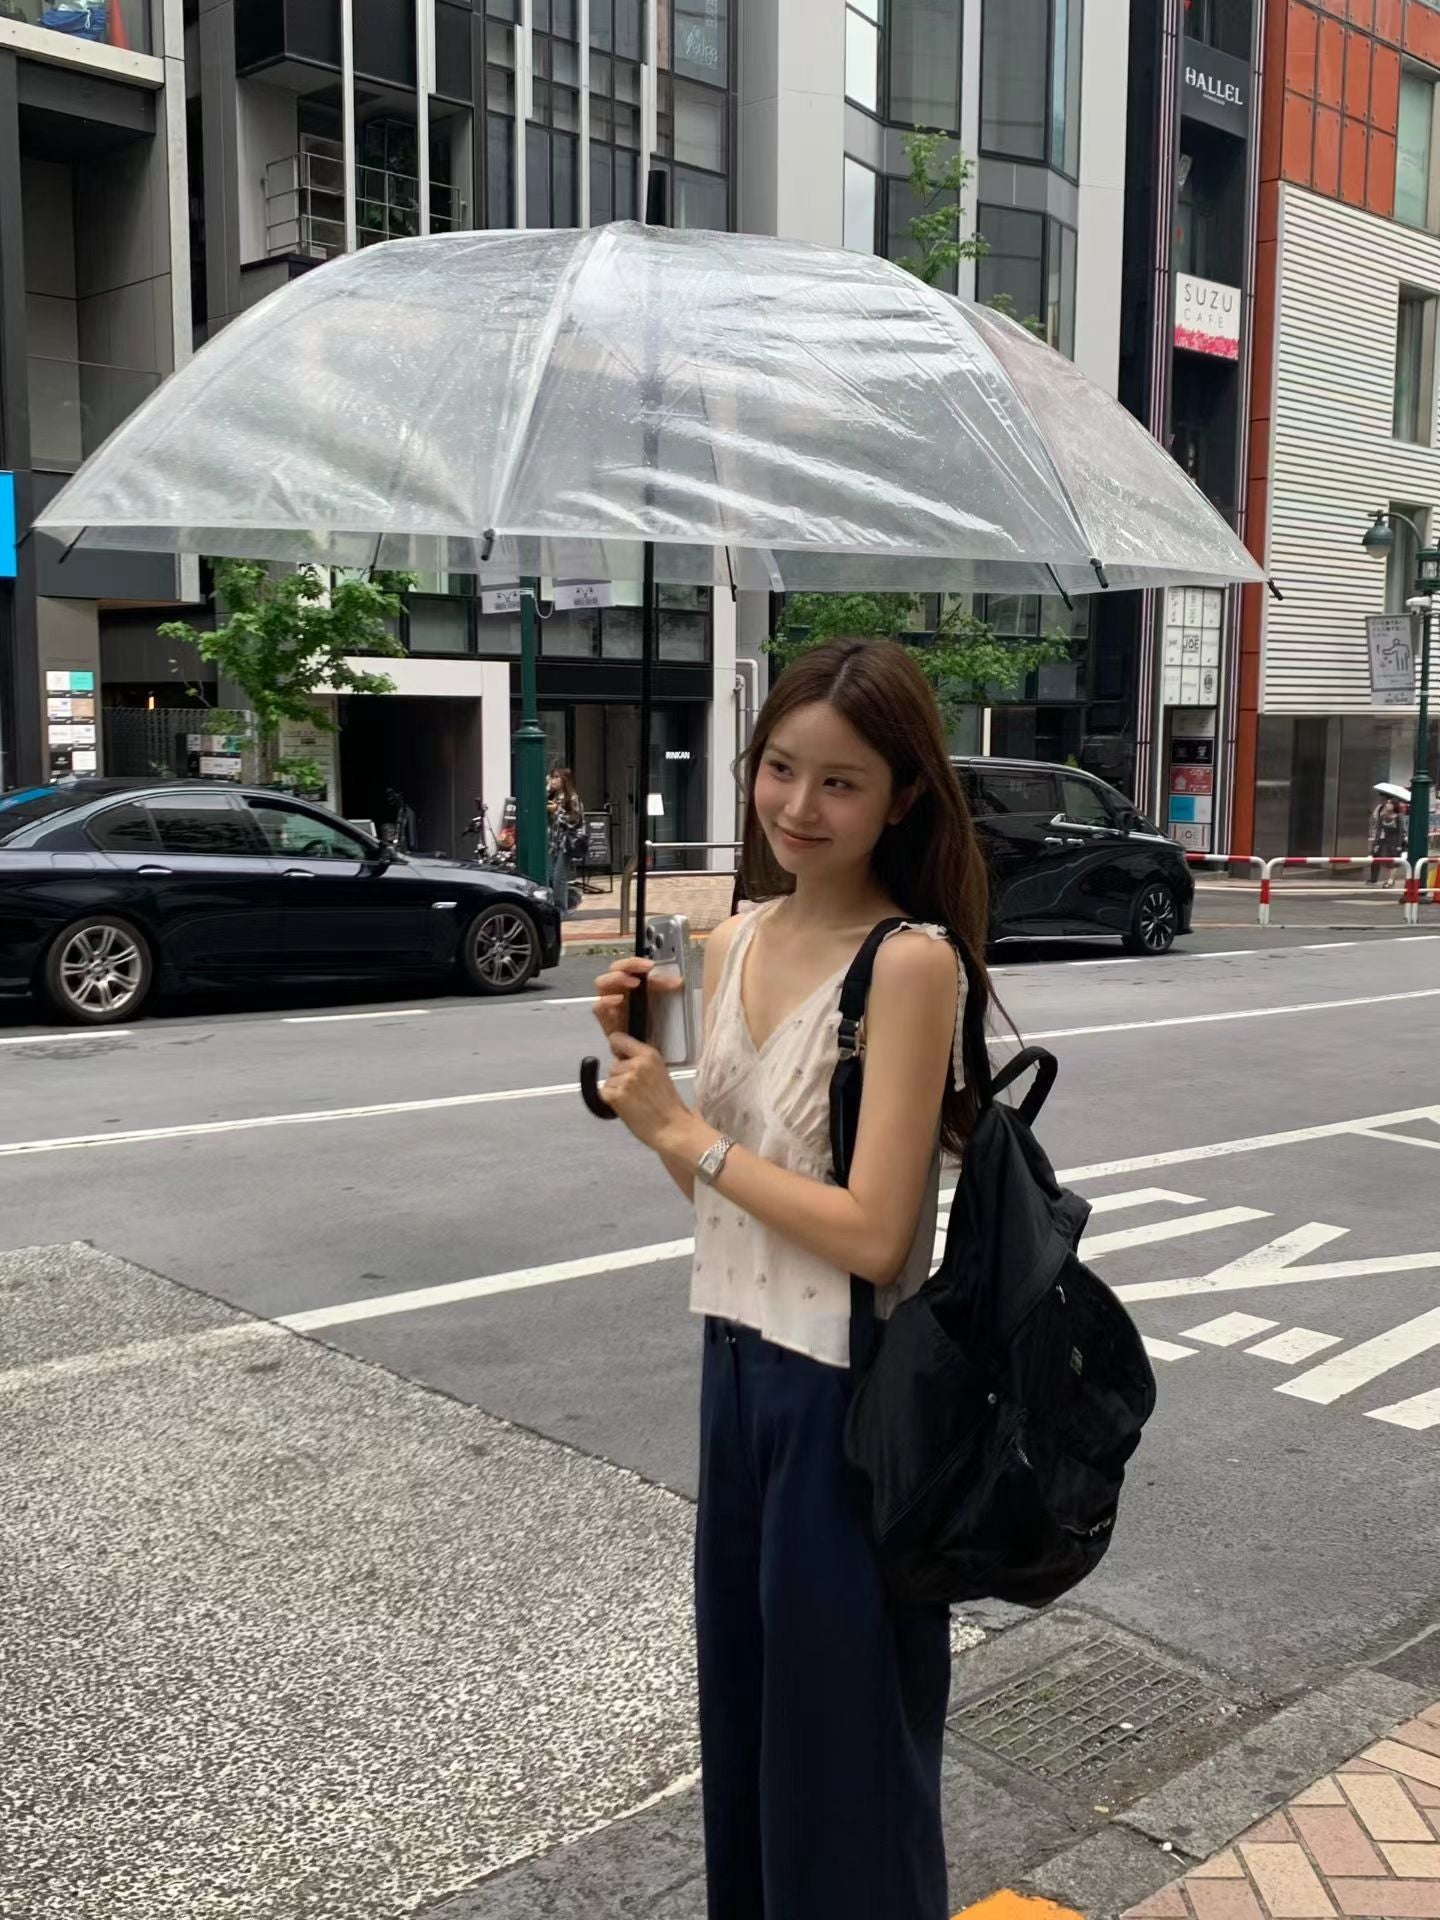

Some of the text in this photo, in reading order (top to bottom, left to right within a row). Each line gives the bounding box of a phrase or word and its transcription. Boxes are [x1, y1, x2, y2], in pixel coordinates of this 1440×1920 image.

[1185, 66, 1243, 105] HALLEL
[1184, 283, 1233, 313] SUZU
[1184, 307, 1225, 329] CAFE
[1183, 638, 1200, 649] JOE
[665, 751, 691, 759] RINKAN
